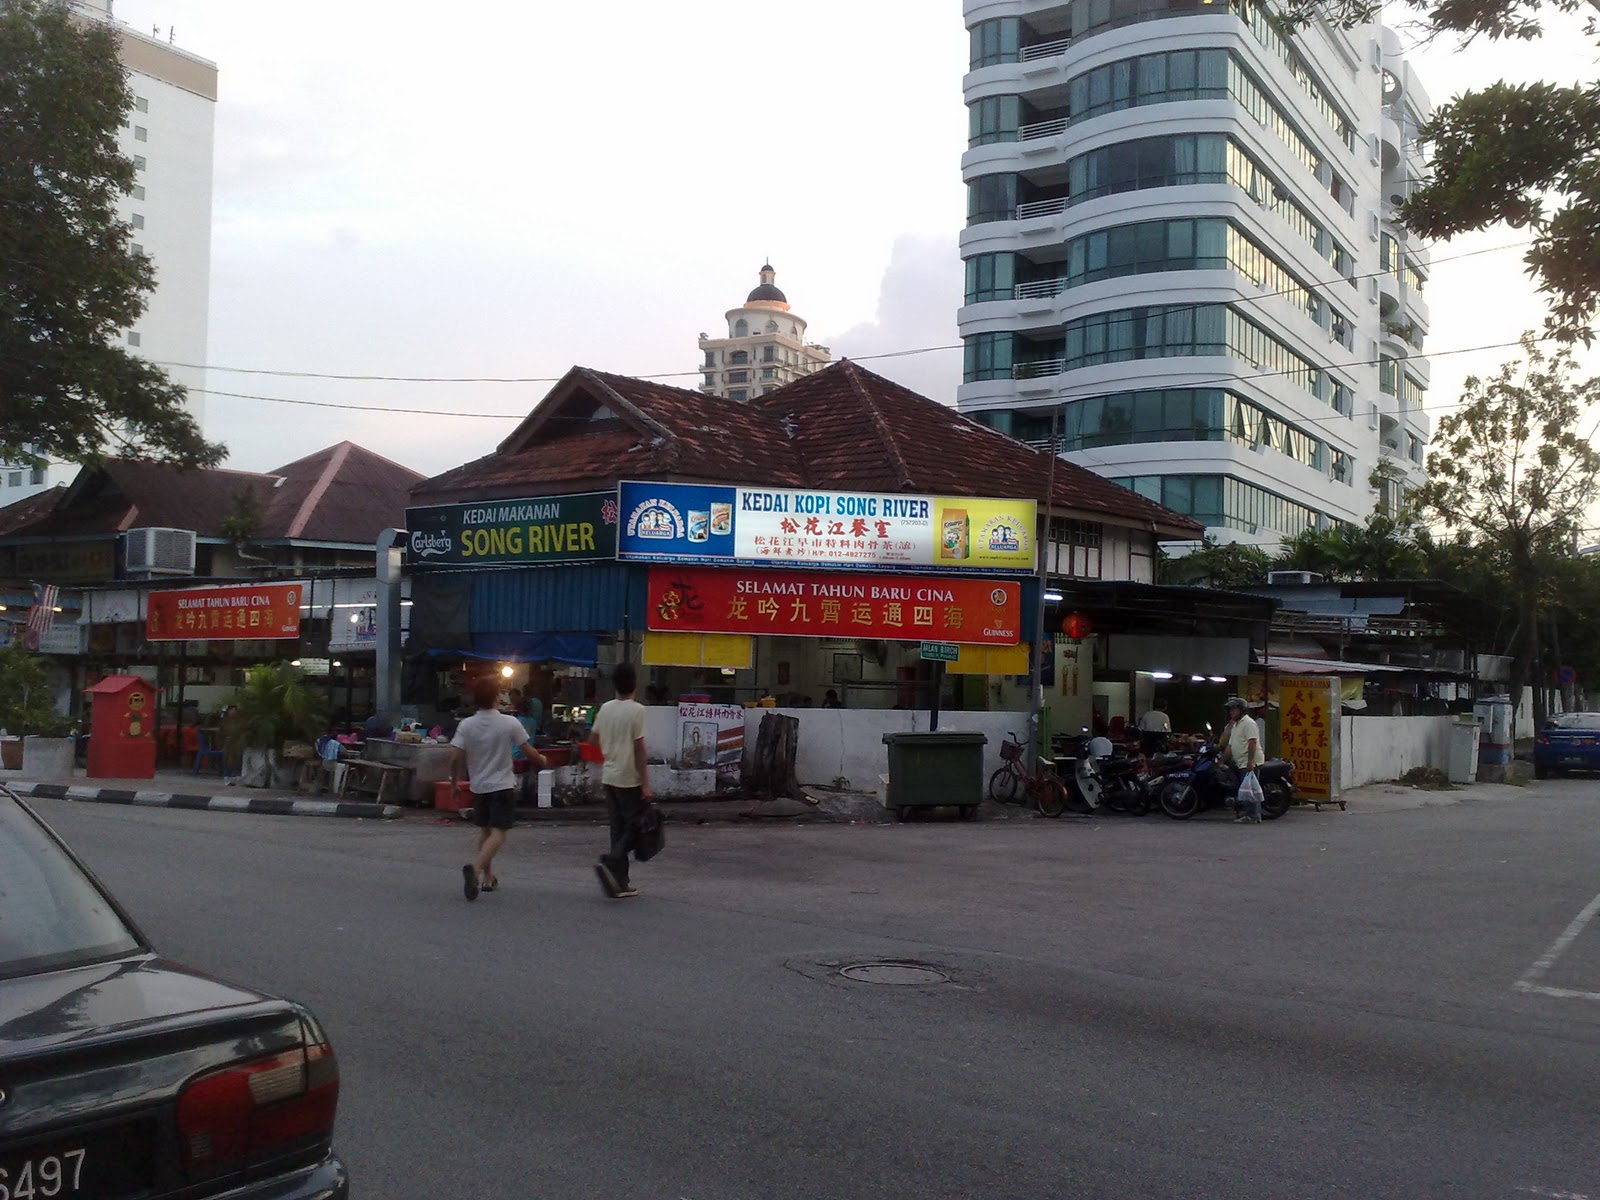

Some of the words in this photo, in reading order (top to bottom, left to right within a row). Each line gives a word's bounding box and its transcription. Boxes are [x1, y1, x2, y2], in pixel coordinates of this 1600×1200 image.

[463, 507, 497, 524] KEDAI
[499, 503, 560, 522] MAKANAN
[742, 492, 789, 513] KEDAI
[794, 494, 830, 514] KOPI
[836, 496, 877, 516] SONG
[883, 498, 929, 518] RIVER
[780, 516, 891, 539] 松花江餐室
[411, 529, 452, 553] Carlsberg
[461, 526, 522, 557] SONG
[529, 522, 595, 554] RIVER
[178, 598, 205, 609] SELAMAT
[207, 597, 230, 608] TAHUN
[231, 596, 250, 607] BARU
[251, 595, 270, 606] CINA
[736, 580, 805, 596] SELAMAT
[810, 583, 865, 599] TAHUN
[871, 586, 911, 600] BARU
[916, 588, 954, 602] CINA
[727, 595, 964, 629] 龙吟九霄运通四海
[983, 627, 1014, 638] GUINNESS
[1290, 746, 1320, 760] FOOD
[1291, 759, 1329, 773] ASTER
